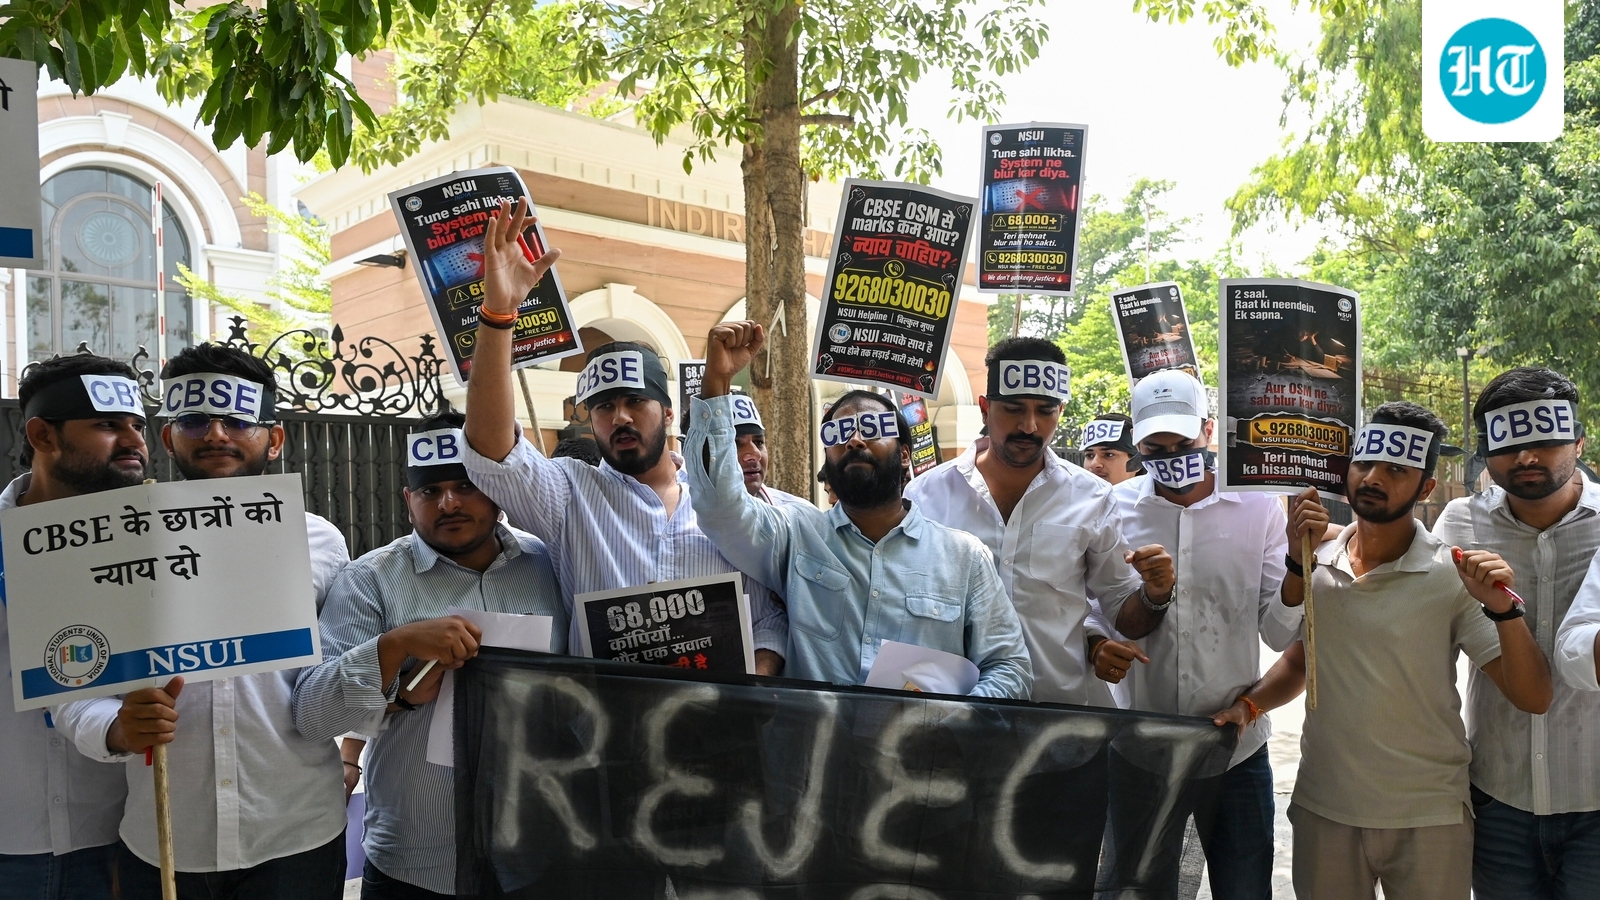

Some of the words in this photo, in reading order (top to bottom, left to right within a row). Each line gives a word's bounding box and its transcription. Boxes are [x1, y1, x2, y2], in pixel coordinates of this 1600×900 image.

[1018, 130, 1044, 142] NSUI
[992, 149, 1017, 159] Tune
[1018, 147, 1040, 157] sahi
[1043, 147, 1075, 158] likha.
[993, 169, 1015, 179] blur
[1017, 168, 1036, 178] kar
[1039, 168, 1070, 180] diya.
[1000, 159, 1043, 170] System
[1046, 159, 1062, 169] ne
[442, 180, 477, 199] NSUI
[414, 210, 450, 226] Tune
[452, 198, 481, 215] sahi
[647, 196, 745, 243] INDIR
[862, 198, 903, 219] CBSE
[904, 201, 940, 222] OSM
[941, 211, 956, 230] से
[1007, 214, 1057, 226] 68,000+
[431, 212, 489, 235] System
[851, 216, 894, 234] marks
[897, 220, 922, 237] कम
[923, 226, 960, 247] आए?
[427, 232, 457, 249] blur
[459, 225, 484, 239] kar
[993, 239, 1007, 247] blur
[1018, 232, 1047, 240] mehnat
[852, 236, 893, 256] न्याय
[894, 238, 953, 269] चाहिए?
[998, 252, 1064, 265] 9268030030
[1033, 274, 1056, 283] justice
[834, 273, 951, 319] 9268030030
[1235, 290, 1241, 299] 2
[1243, 289, 1267, 299] saal.
[837, 307, 856, 318] NSUI
[857, 309, 888, 321] Helpline
[1119, 301, 1134, 310] Raat
[1121, 309, 1130, 317] Ek
[1129, 306, 1148, 316] sapna.
[1235, 299, 1259, 310] Raat
[1260, 299, 1270, 310] ki
[1272, 300, 1317, 314] neendein.
[1235, 310, 1248, 320] Ek
[1250, 311, 1283, 321] sapna.
[1337, 311, 1352, 319] NSUI
[461, 315, 479, 326] blur
[524, 327, 541, 336] FREE
[853, 327, 880, 343] NSUI
[881, 331, 907, 346] आपके
[907, 337, 926, 352] साथ
[926, 340, 934, 354] है
[532, 337, 556, 351] justice
[829, 344, 847, 355] न्याय
[847, 345, 860, 356] होने
[860, 348, 872, 357] तक
[890, 351, 907, 364] जारी
[685, 365, 706, 379] 68,0
[1142, 360, 1154, 369] sab
[577, 357, 639, 399] CBSE
[1003, 364, 1068, 395] CBSE
[165, 378, 258, 415] CBSE
[1265, 381, 1286, 395] Aur
[1289, 382, 1312, 397] OSM
[1314, 388, 1327, 399] ne
[1250, 395, 1271, 406] sab
[1273, 394, 1297, 407] blur
[1299, 396, 1315, 409] kar
[1317, 400, 1343, 414] diya?
[819, 411, 899, 447] CBSE
[1269, 421, 1343, 444] 9268030030
[1489, 405, 1571, 442] CBSE
[1082, 423, 1122, 445] CBSE
[1262, 436, 1281, 444] NSUI
[1282, 437, 1308, 446] Helpline
[1314, 441, 1328, 449] Free
[1328, 443, 1339, 451] Call
[411, 434, 458, 461] CB
[1354, 428, 1427, 463] CBSE
[1263, 451, 1286, 463] Teri
[1289, 453, 1328, 469] mehnat
[1243, 463, 1258, 475] ka
[1261, 463, 1302, 476] hisaab
[1304, 468, 1343, 484] maango.
[22, 514, 114, 556] CBSE
[120, 504, 151, 537] के
[157, 496, 235, 532] छात्रों
[240, 492, 284, 524] को
[90, 557, 159, 586] न्याय
[164, 544, 201, 580] दो
[606, 589, 706, 633] 68,000
[49, 627, 86, 653] STUDENTS'
[86, 629, 106, 648] UNION
[641, 645, 668, 661] एक
[670, 636, 713, 654] सवाल
[99, 650, 107, 661] OF
[146, 638, 246, 675] NSUI
[47, 653, 70, 685] NATIONAL
[86, 661, 105, 680] INDIA
[486, 668, 1227, 880] REJECT
